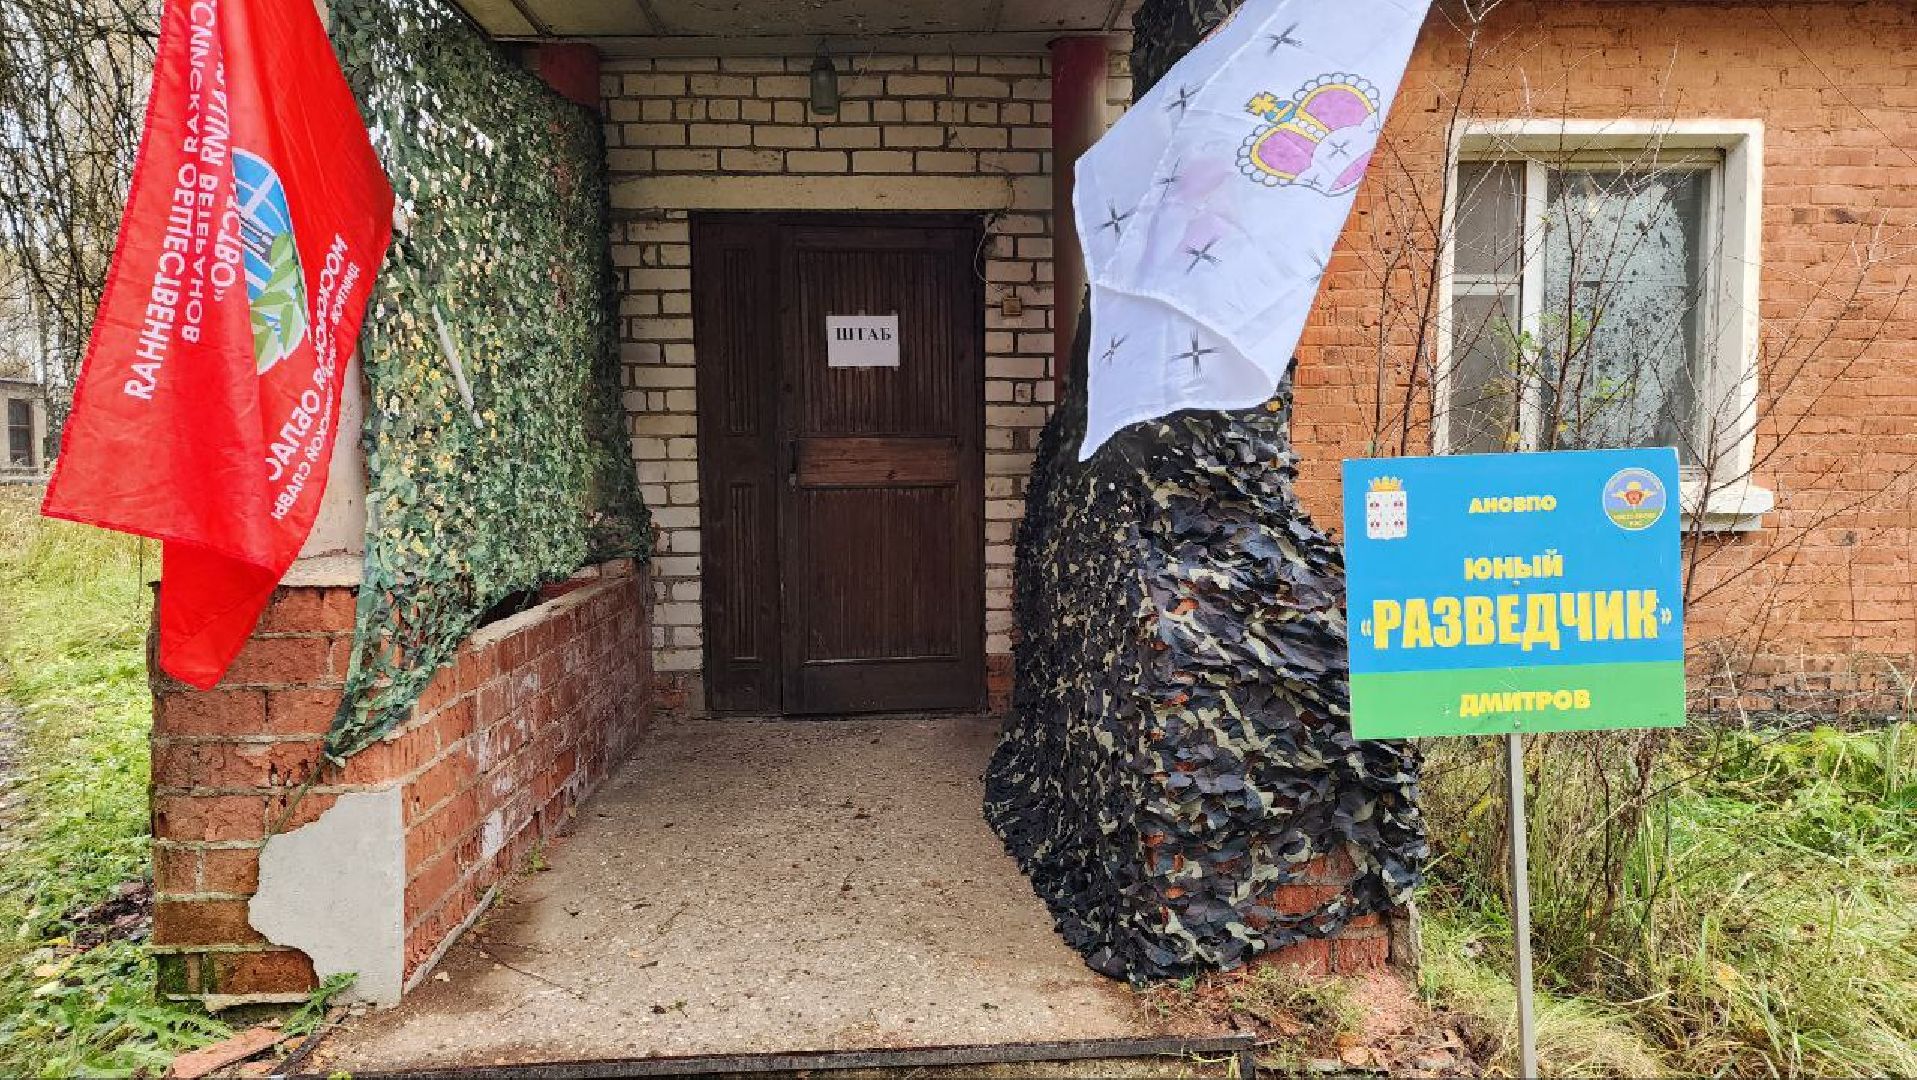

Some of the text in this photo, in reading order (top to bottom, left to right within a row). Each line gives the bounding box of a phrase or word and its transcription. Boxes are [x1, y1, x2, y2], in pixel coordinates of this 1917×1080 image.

[833, 327, 892, 341] ШТАБ
[1469, 495, 1558, 514] АНОВПО
[1464, 548, 1563, 581] ЮНЫЙ
[1360, 589, 1673, 652] «РАЗВЕДЧИК»
[1459, 689, 1592, 717] ДМИТРОВ
